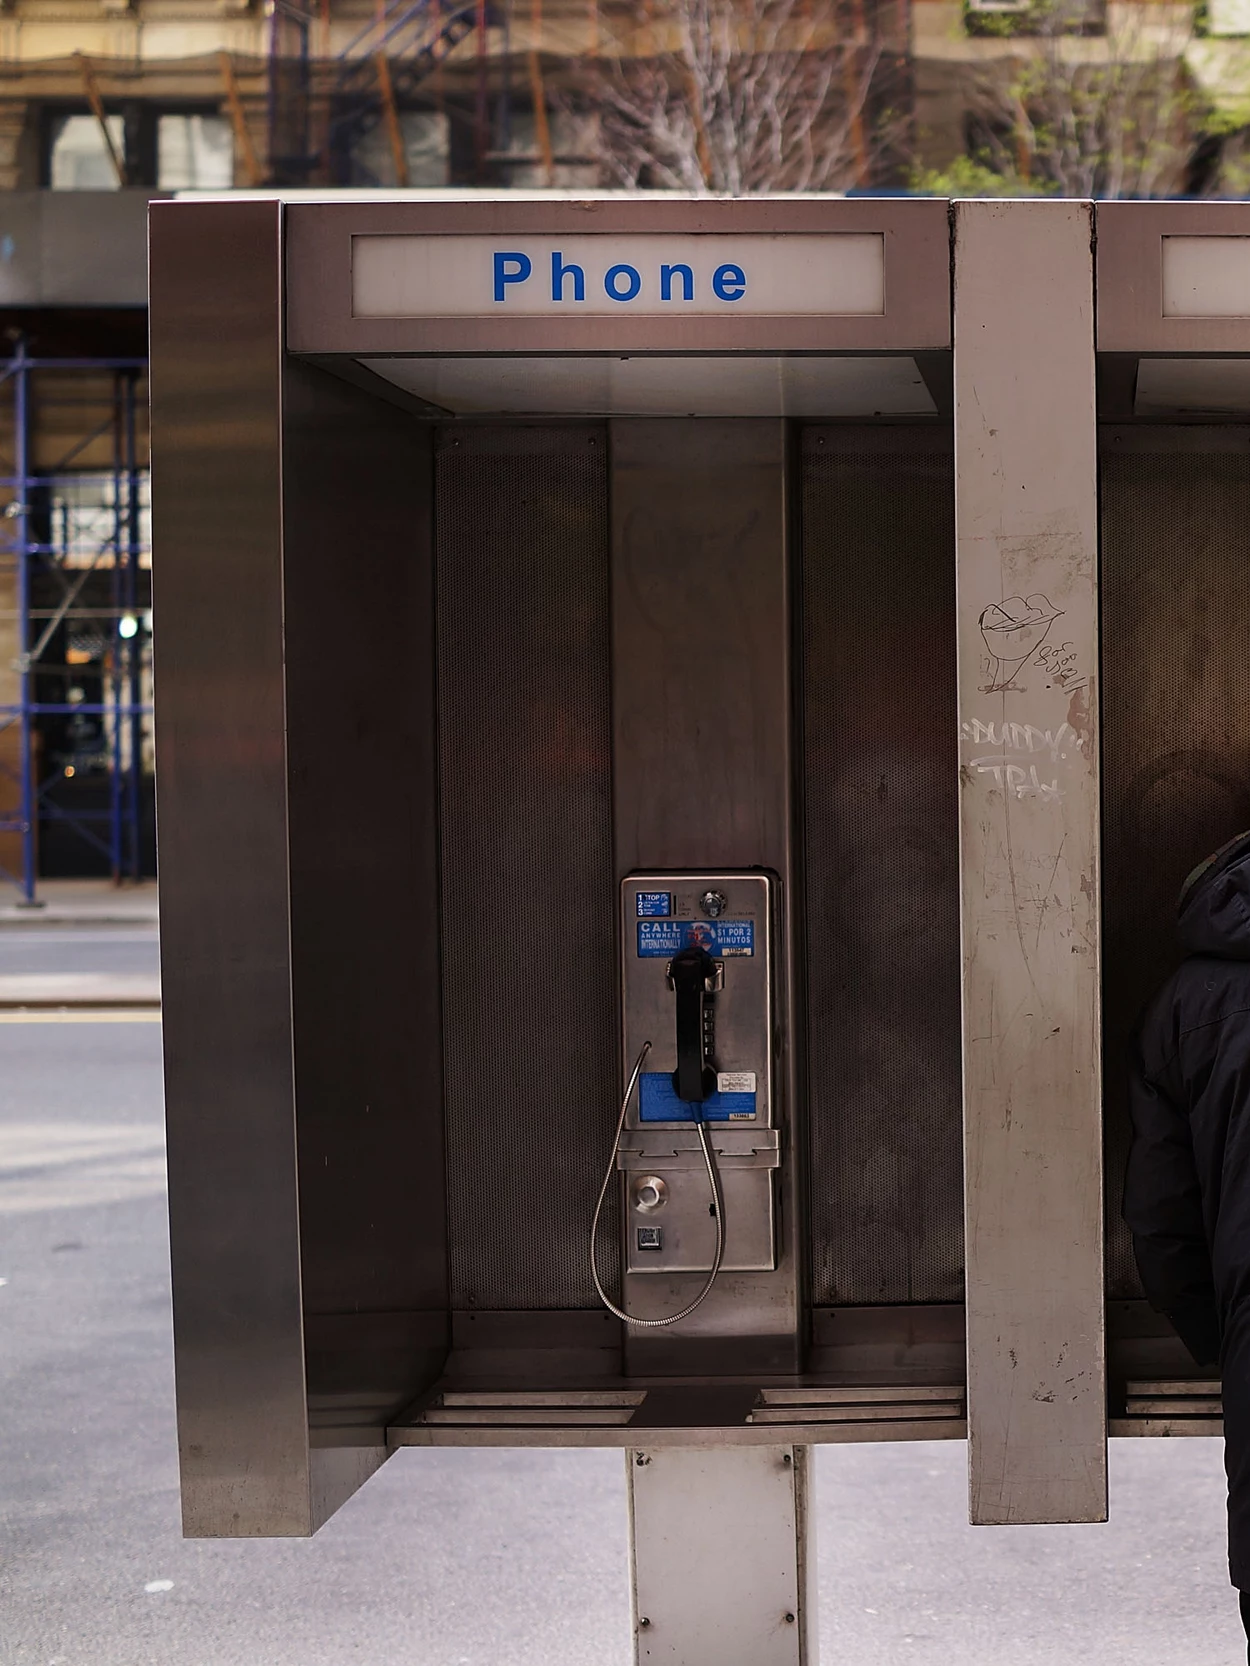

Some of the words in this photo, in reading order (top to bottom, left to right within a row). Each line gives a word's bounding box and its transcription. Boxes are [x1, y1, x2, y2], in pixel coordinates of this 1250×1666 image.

[493, 251, 747, 302] Phone
[641, 923, 681, 932] CALL
[729, 928, 744, 936] POR
[746, 928, 752, 936] 2
[641, 939, 681, 949] INTERNATIONALLY
[717, 936, 751, 944] MINUTOS
